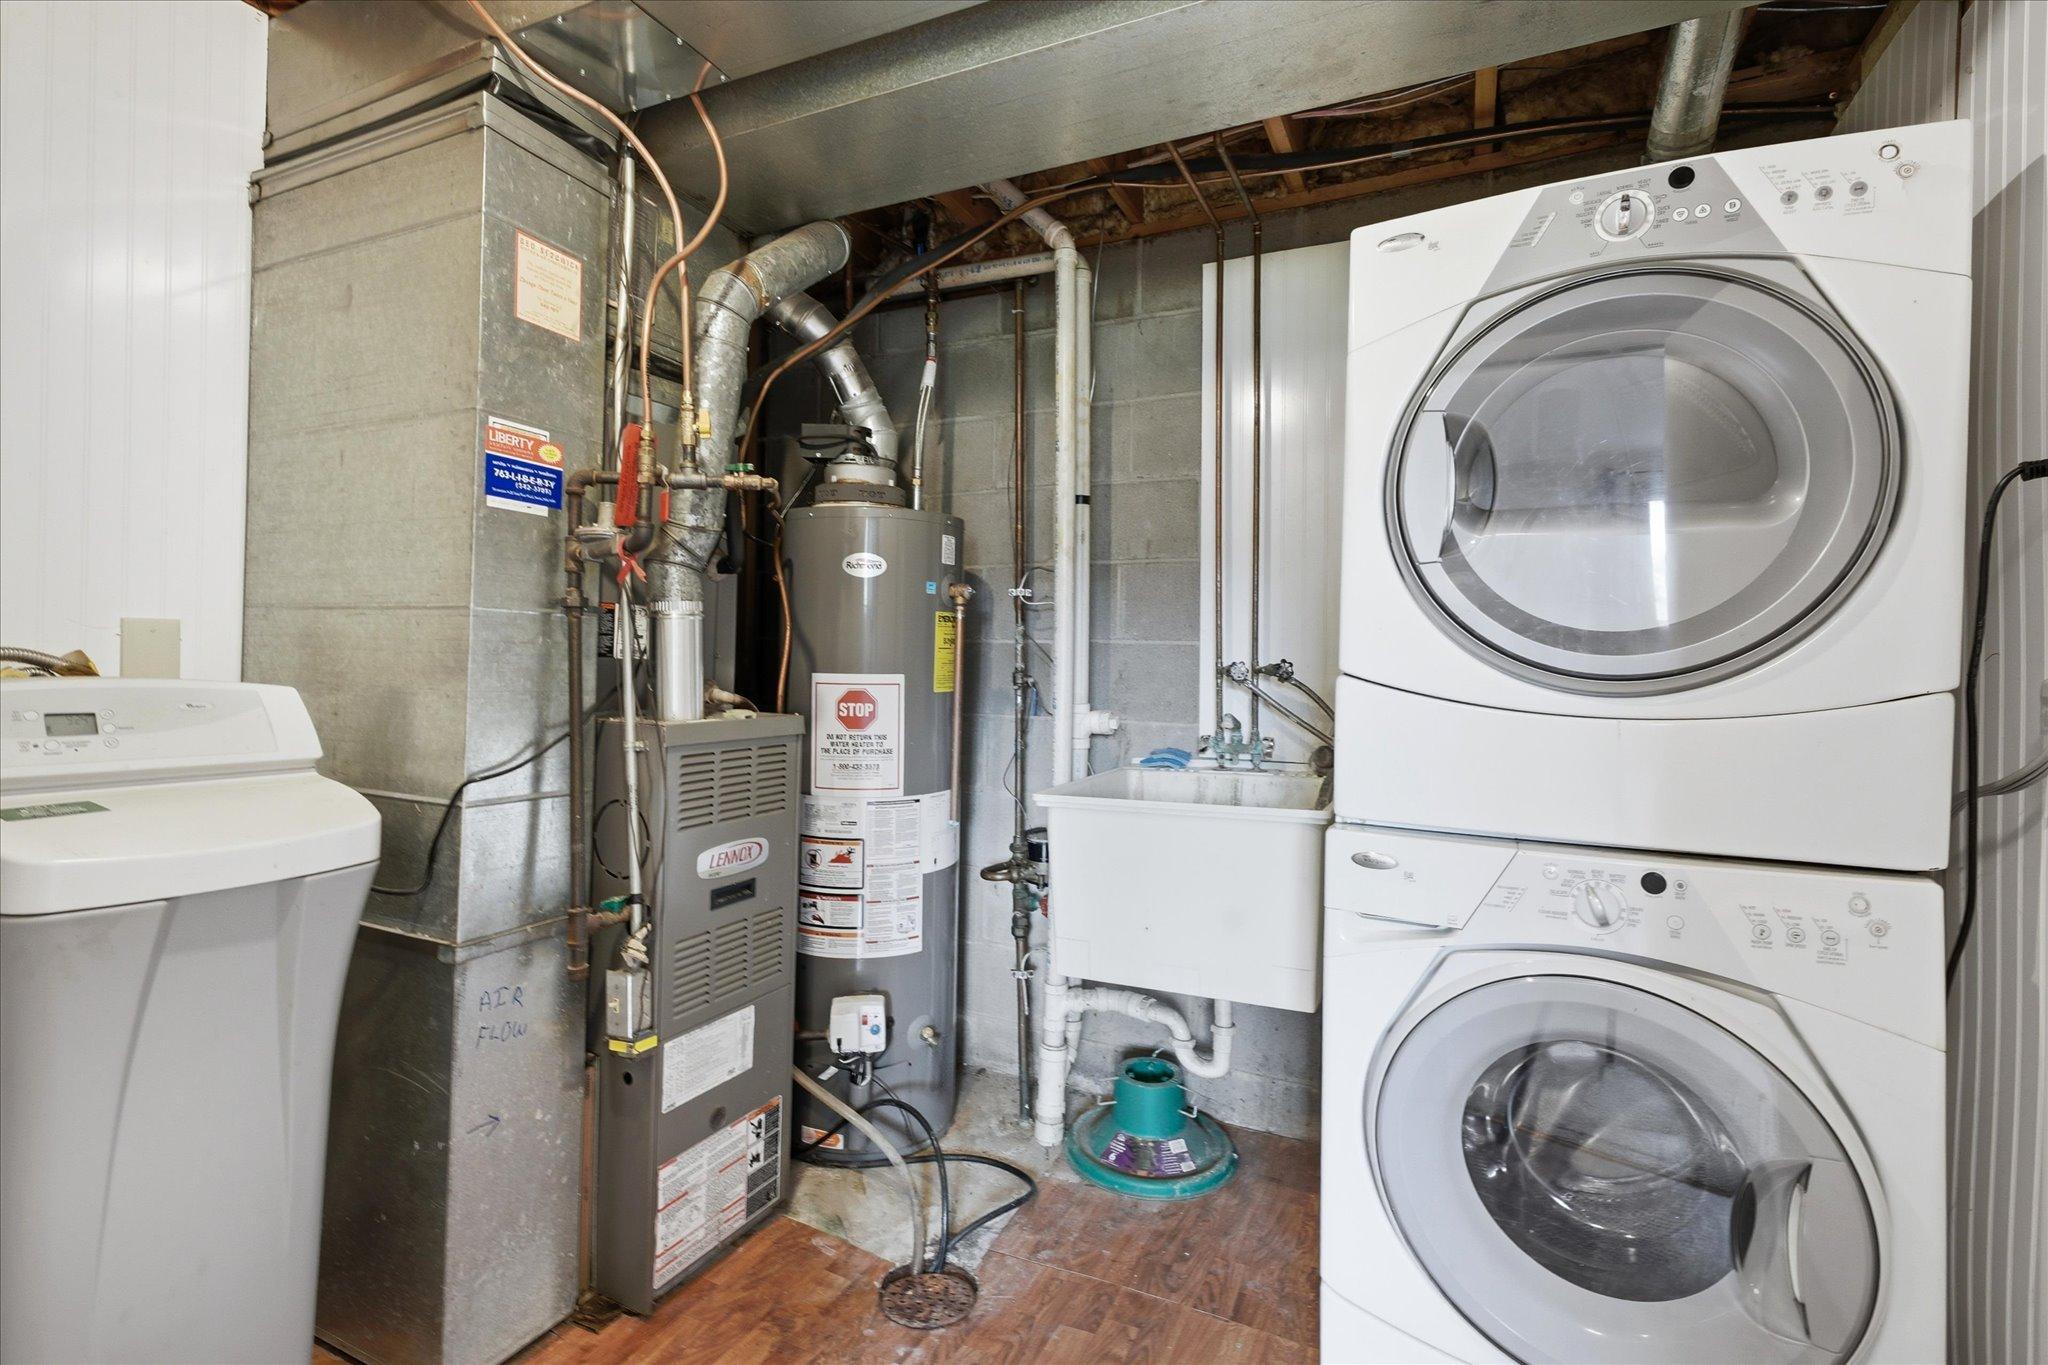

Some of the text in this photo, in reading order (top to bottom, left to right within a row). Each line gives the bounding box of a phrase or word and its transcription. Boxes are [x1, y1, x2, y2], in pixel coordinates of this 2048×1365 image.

[488, 429, 535, 451] LIBERTY
[839, 702, 874, 717] STOP
[820, 747, 831, 755] THE
[709, 845, 753, 869] LENNOX
[479, 986, 523, 1012] AIR
[475, 1021, 528, 1048] FLOW
